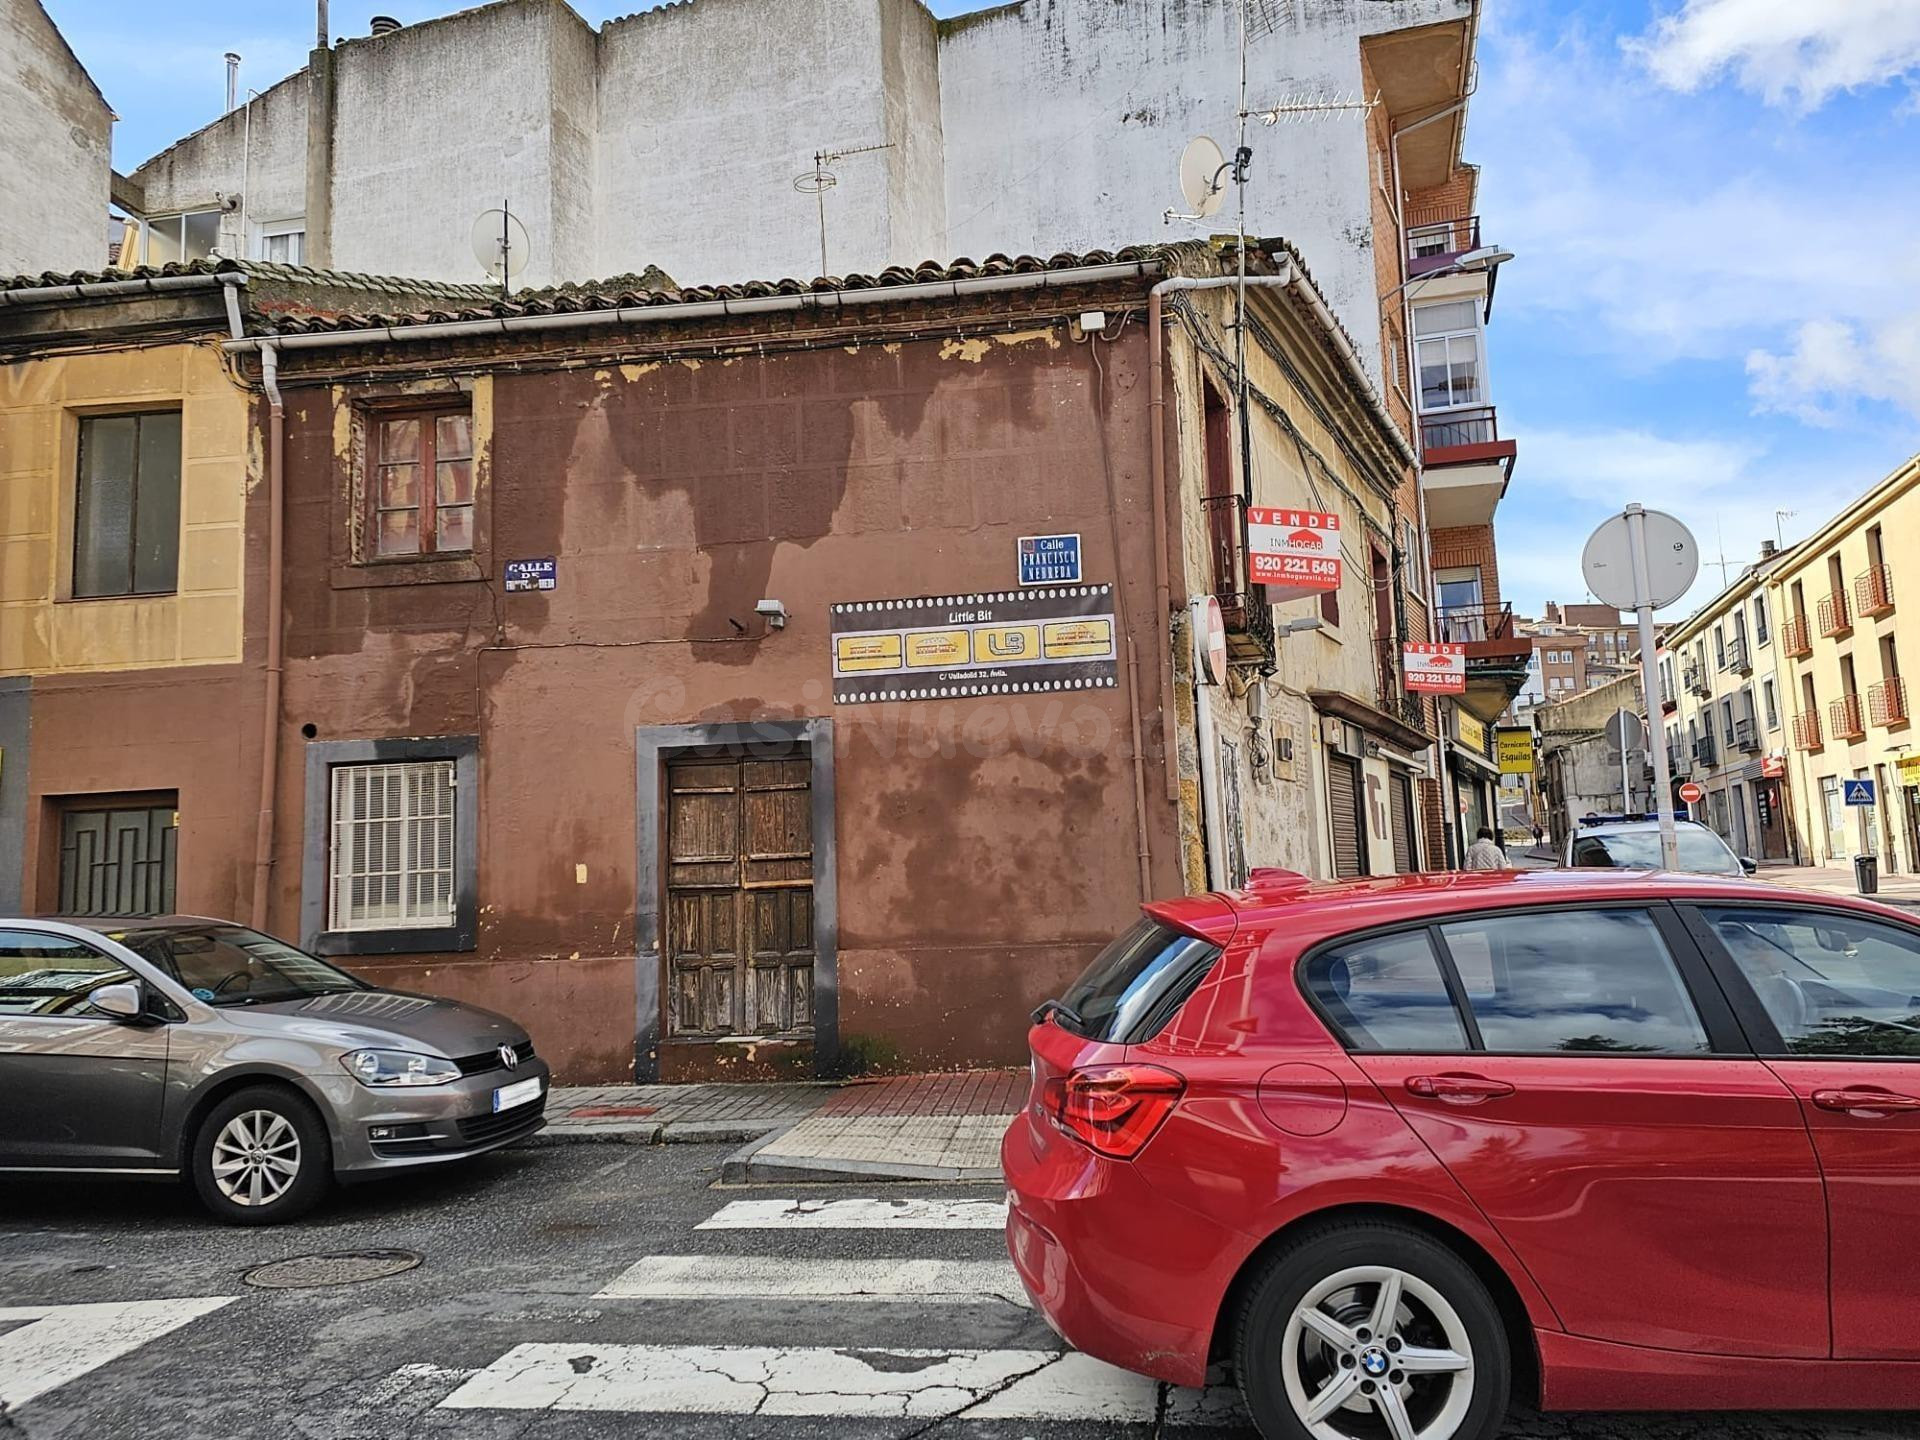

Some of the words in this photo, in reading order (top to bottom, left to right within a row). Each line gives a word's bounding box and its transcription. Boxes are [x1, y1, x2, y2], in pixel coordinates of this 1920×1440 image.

[1253, 511, 1336, 529] VENDE
[1040, 539, 1064, 550] Calle
[1269, 537, 1323, 551] INMHOGAR
[1023, 551, 1075, 566] FRANCISCO
[1255, 556, 1281, 571] 920
[1284, 558, 1309, 573] 221
[1312, 560, 1337, 575] 549
[508, 562, 553, 573] CALLE
[1028, 566, 1072, 580] NEBREDA
[949, 610, 975, 623] Little
[978, 609, 993, 621] Bit
[1406, 644, 1462, 655] VENDE
[1408, 672, 1425, 682] 920
[1426, 674, 1443, 683] 221
[1445, 674, 1462, 684] 549
